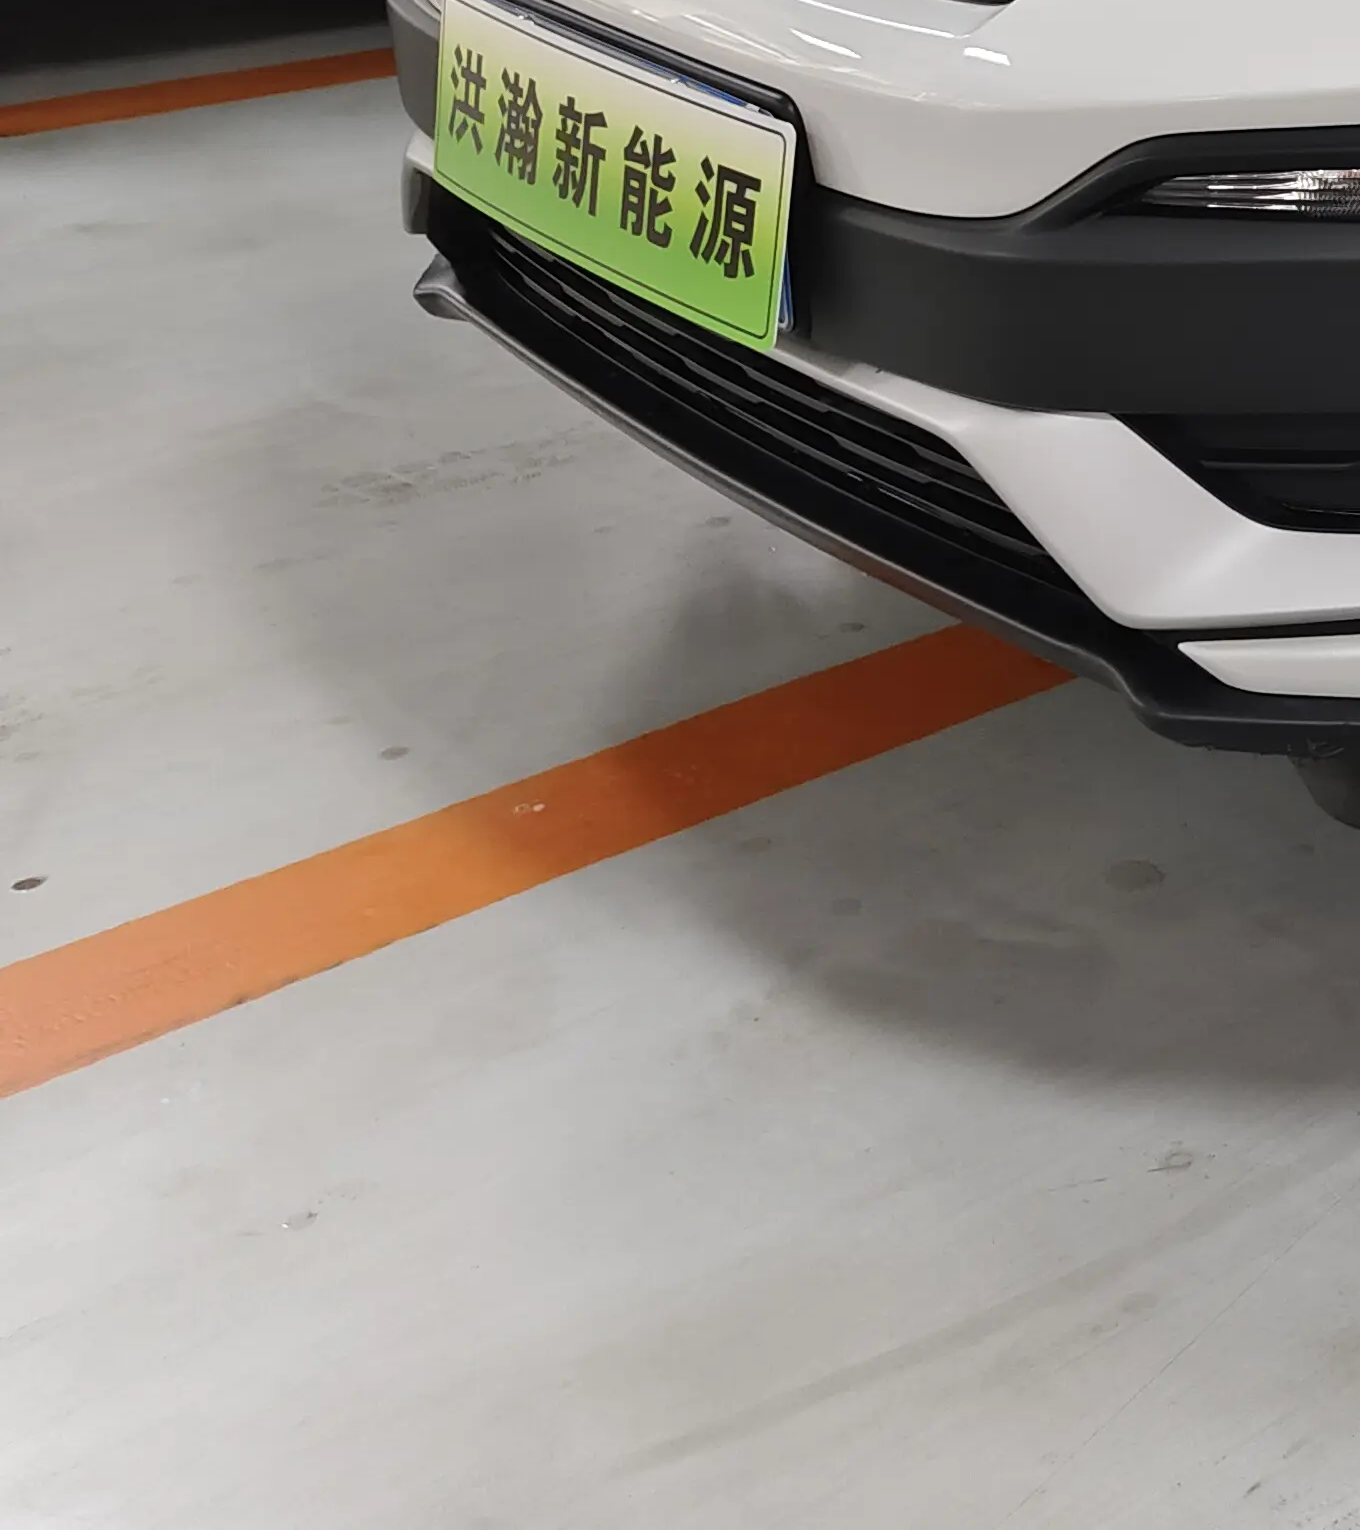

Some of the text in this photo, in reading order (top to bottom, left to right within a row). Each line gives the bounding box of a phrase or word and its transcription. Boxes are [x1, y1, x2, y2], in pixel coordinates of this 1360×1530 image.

[448, 43, 762, 279] 洪瀚新能源
